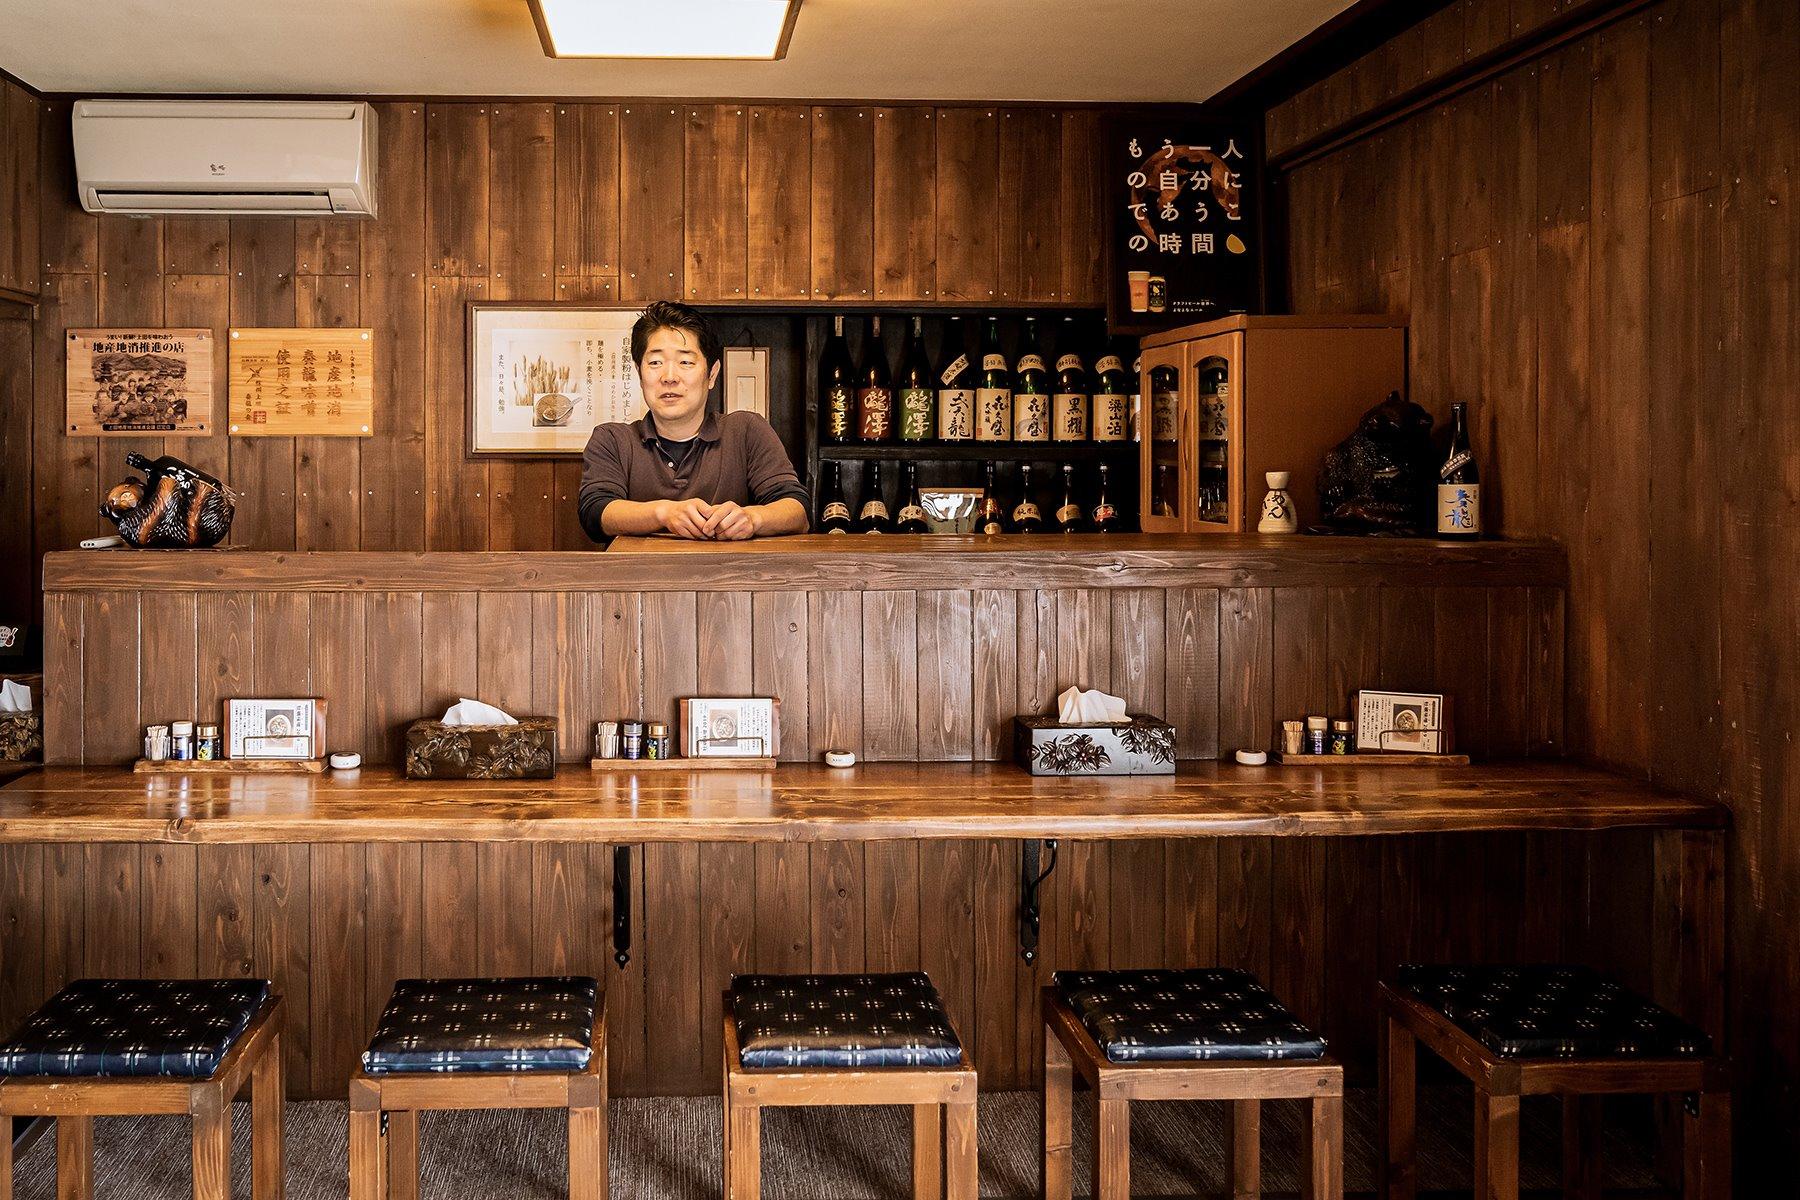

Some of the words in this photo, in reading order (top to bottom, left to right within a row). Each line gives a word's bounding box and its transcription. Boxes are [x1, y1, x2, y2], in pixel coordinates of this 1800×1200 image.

[1128, 138, 1243, 159] もう一人
[1127, 169, 1242, 191] の自分に
[1127, 202, 1241, 222] であうこ
[1128, 232, 1214, 254] の時間
[93, 342, 184, 353] 地産地消推進の店
[327, 349, 342, 416] 地産地消
[1107, 399, 1123, 436] 梁山泊
